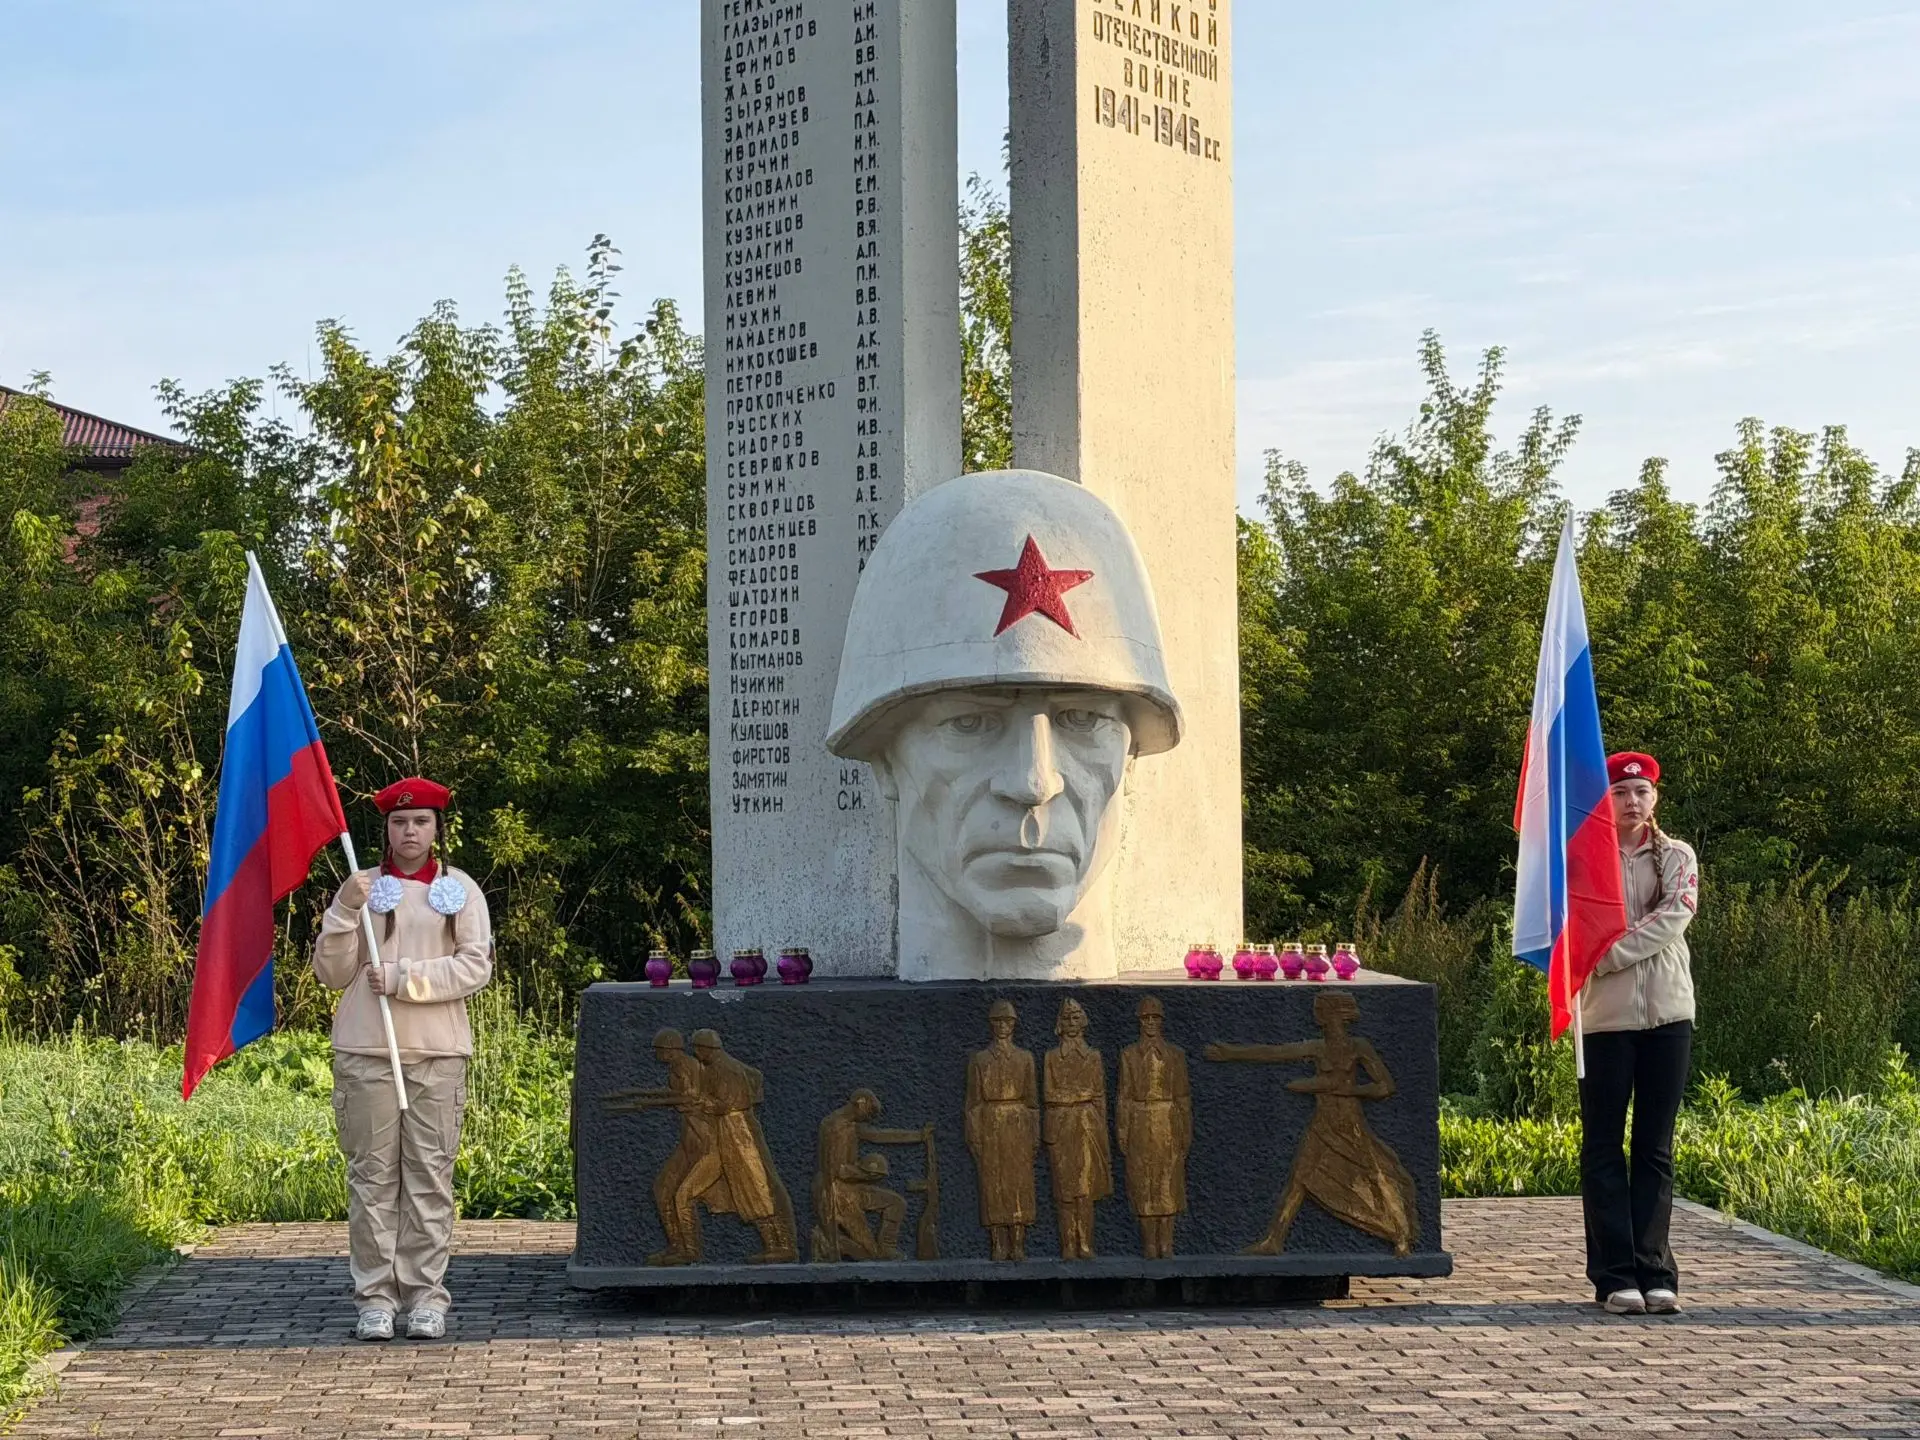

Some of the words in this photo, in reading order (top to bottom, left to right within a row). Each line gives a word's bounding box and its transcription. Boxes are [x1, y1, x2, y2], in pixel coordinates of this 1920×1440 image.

[724, 3, 802, 41] ГЛАЗЫРИН
[1093, 0, 1217, 47] ЛИКОЙ
[724, 20, 816, 62] ДОЛМАТОВ
[1093, 11, 1217, 82] ОТЕЧЕСТВЕННОЙ
[725, 47, 795, 82] ЕФИМОВ
[725, 75, 775, 103] ЖАБО
[1124, 58, 1190, 108] ВОЙНЕ
[725, 86, 805, 123] ЗЫРЯНОВ
[725, 106, 808, 143] ЗАМАРУЕВ
[1094, 85, 1200, 156] 1941-1945
[725, 169, 813, 204] КОНОВАЛОВ
[726, 194, 797, 225] КАЛИНИН
[726, 213, 803, 246] КУЗНЕЦОВ
[726, 237, 793, 267] КУЛАГИН
[726, 258, 801, 288] КУЗНЕЦОВ
[726, 284, 776, 309] ЛЕВИН
[727, 304, 780, 331] МУХИН
[726, 322, 806, 352] НАЙДЕНОВ
[727, 370, 782, 394] ПЕТРОВ
[727, 382, 835, 417] ПРОКОПЧЕНКО
[728, 410, 801, 436] РУССКИХ
[728, 431, 803, 457] СИДОРОВ
[728, 450, 819, 478] СЕВРЮКОВ
[728, 476, 785, 500] СУМИН
[728, 495, 815, 521] СКВОРЦОВ
[728, 519, 816, 544] СМОЛЕНЦЕВ
[729, 543, 796, 565] СИДОРОВ
[728, 565, 798, 587] ФЕДОСОВ
[729, 586, 799, 607] ШАТОХИН
[730, 607, 788, 627] ЕГОРОВ
[730, 629, 799, 649] КОМАРОВ
[731, 651, 802, 670] КЫТМАНОВ
[732, 698, 799, 718] ДЕРЮГИН
[731, 722, 788, 741] КУЛЕШОВ
[733, 746, 790, 767] ФИРСТОВ
[733, 771, 787, 789] ЗАМЯТИН
[733, 794, 783, 814] УТКИН
